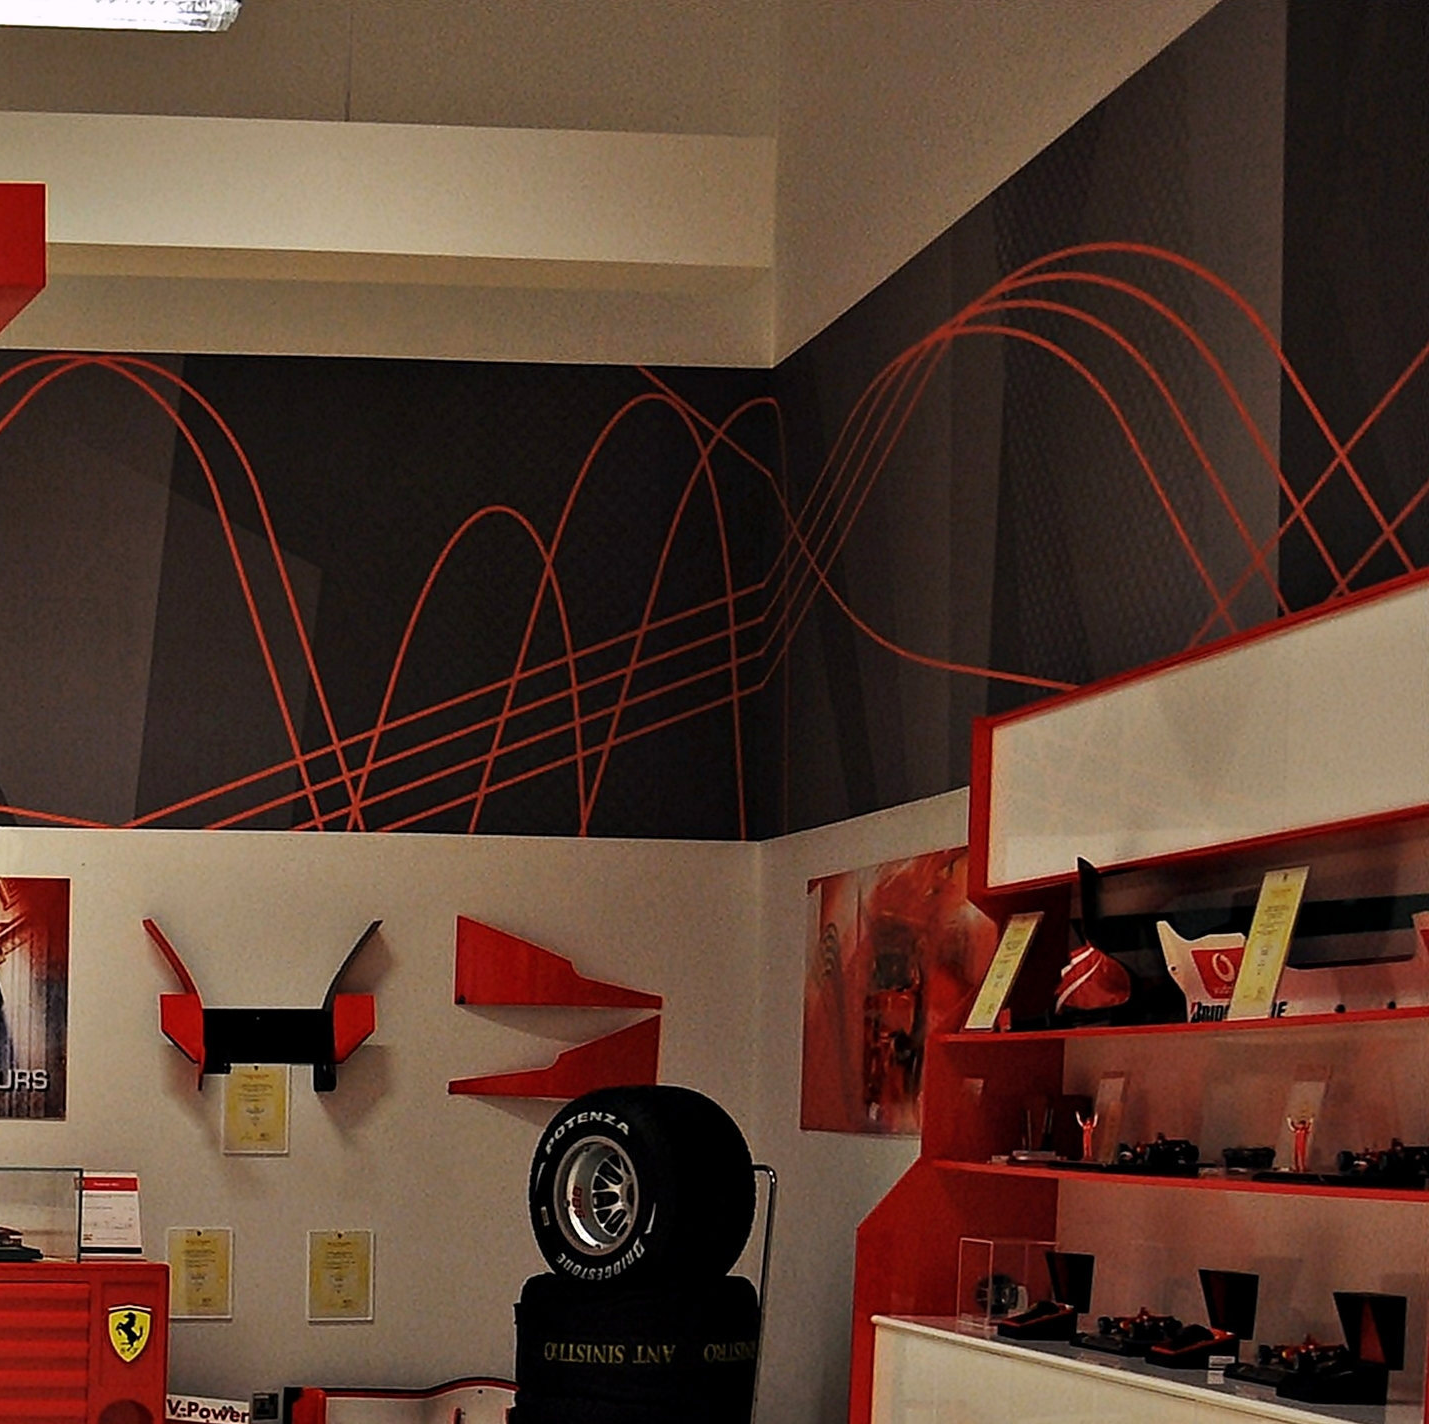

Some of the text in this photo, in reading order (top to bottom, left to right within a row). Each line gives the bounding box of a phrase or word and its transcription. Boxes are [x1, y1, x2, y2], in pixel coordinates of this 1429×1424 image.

[545, 1111, 629, 1154] POTENZA
[556, 1237, 645, 1281] BRIDGESTONE
[632, 1344, 676, 1364] ANT
[167, 1400, 250, 1423] V-Power
